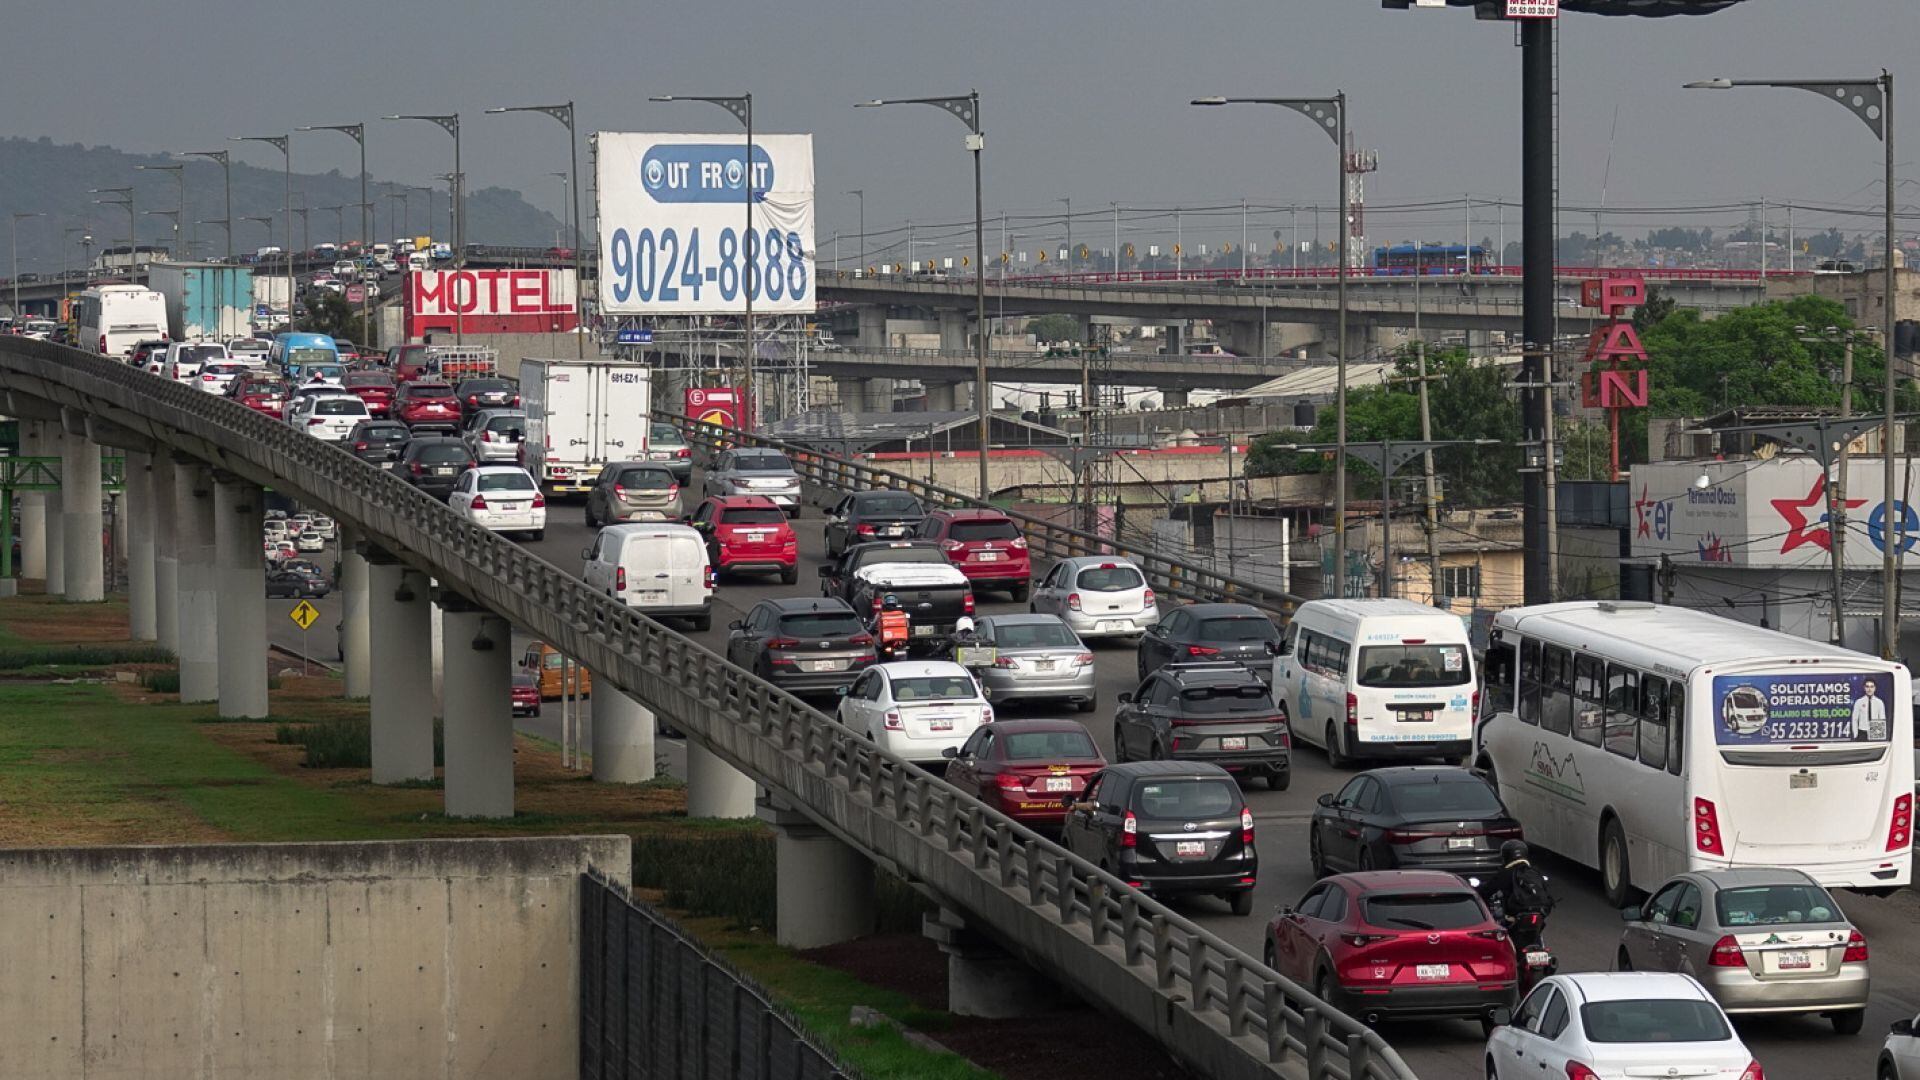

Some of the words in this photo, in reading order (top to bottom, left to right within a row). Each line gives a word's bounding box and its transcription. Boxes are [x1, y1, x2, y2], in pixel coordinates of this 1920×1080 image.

[610, 227, 807, 303] 9024-8888
[414, 271, 573, 314] MOTEL
[1600, 278, 1648, 408] PAN
[1770, 683, 1850, 694] SOLICITAMOS
[1770, 722, 1787, 739] 55
[1788, 721, 1819, 738] 2533
[1820, 721, 1851, 738] 3114
